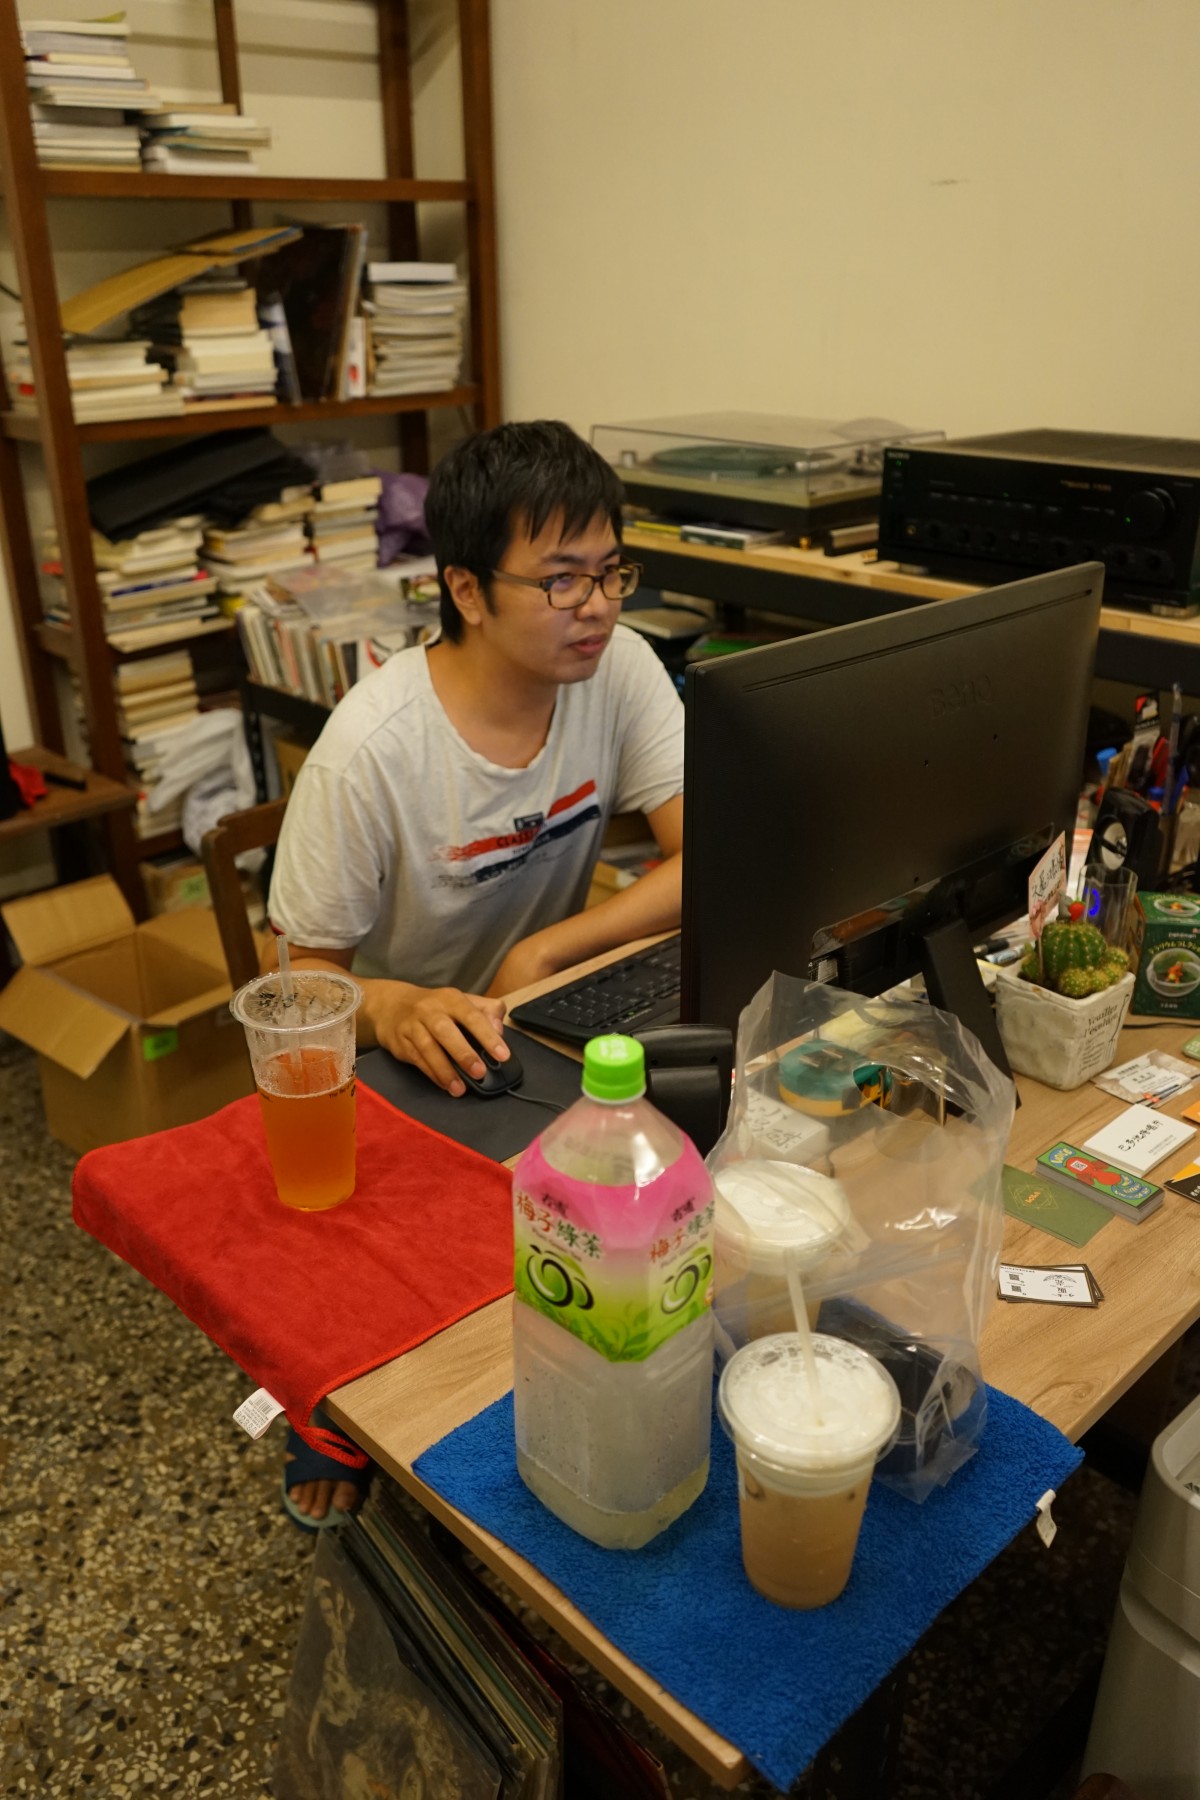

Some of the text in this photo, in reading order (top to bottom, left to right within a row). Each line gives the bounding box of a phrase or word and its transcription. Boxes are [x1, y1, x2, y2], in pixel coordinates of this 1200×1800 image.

[930, 674, 994, 719] BenQ
[516, 1191, 602, 1259] 梅子綠茶
